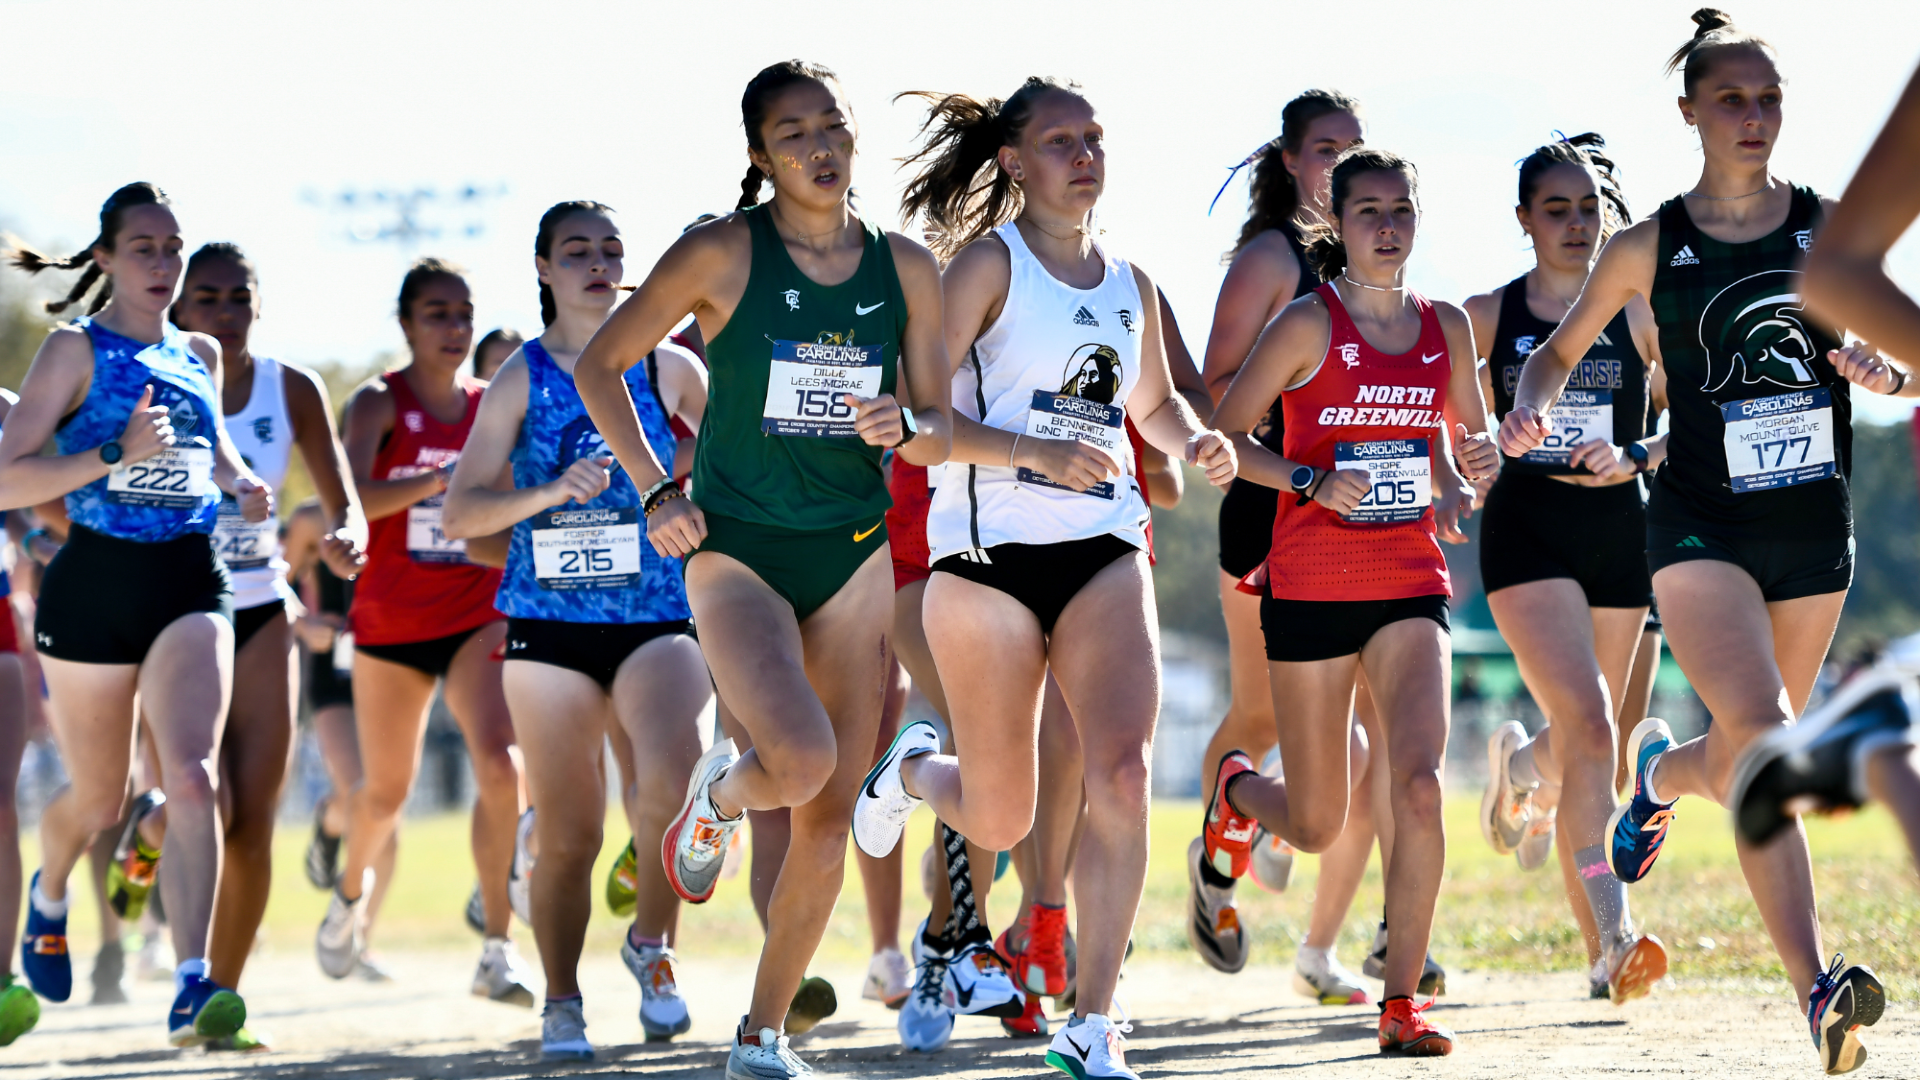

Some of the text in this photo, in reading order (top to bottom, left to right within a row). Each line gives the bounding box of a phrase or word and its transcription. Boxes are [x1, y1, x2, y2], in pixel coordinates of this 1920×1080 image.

[1670, 257, 1700, 267] adidas
[1072, 317, 1099, 328] adidas
[796, 344, 868, 362] CAROLINAS
[812, 343, 862, 353] CONFERENCE
[813, 367, 847, 378] DILLE
[790, 376, 863, 389] LEES-MCRAE
[1353, 385, 1436, 406] NORTH
[1757, 391, 1804, 403] CONFERENCE
[796, 389, 853, 418] 158
[1053, 397, 1110, 420] CAROLINAS
[1742, 395, 1814, 416] CAROLINAS
[1051, 416, 1105, 436] BENNEWITZ
[1755, 414, 1805, 429] MORGAN
[1036, 424, 1061, 437] UNC
[1739, 422, 1820, 443] MOUNT OLIVE
[1353, 444, 1415, 457] CAROLINAS
[1751, 436, 1811, 470] 177
[1368, 461, 1401, 470] SHOPE
[127, 466, 189, 492] 222
[1376, 468, 1428, 479] GREENVILLE
[551, 512, 620, 526] CAROLINAS
[564, 529, 605, 538] FOSTER
[559, 548, 613, 573] 215
